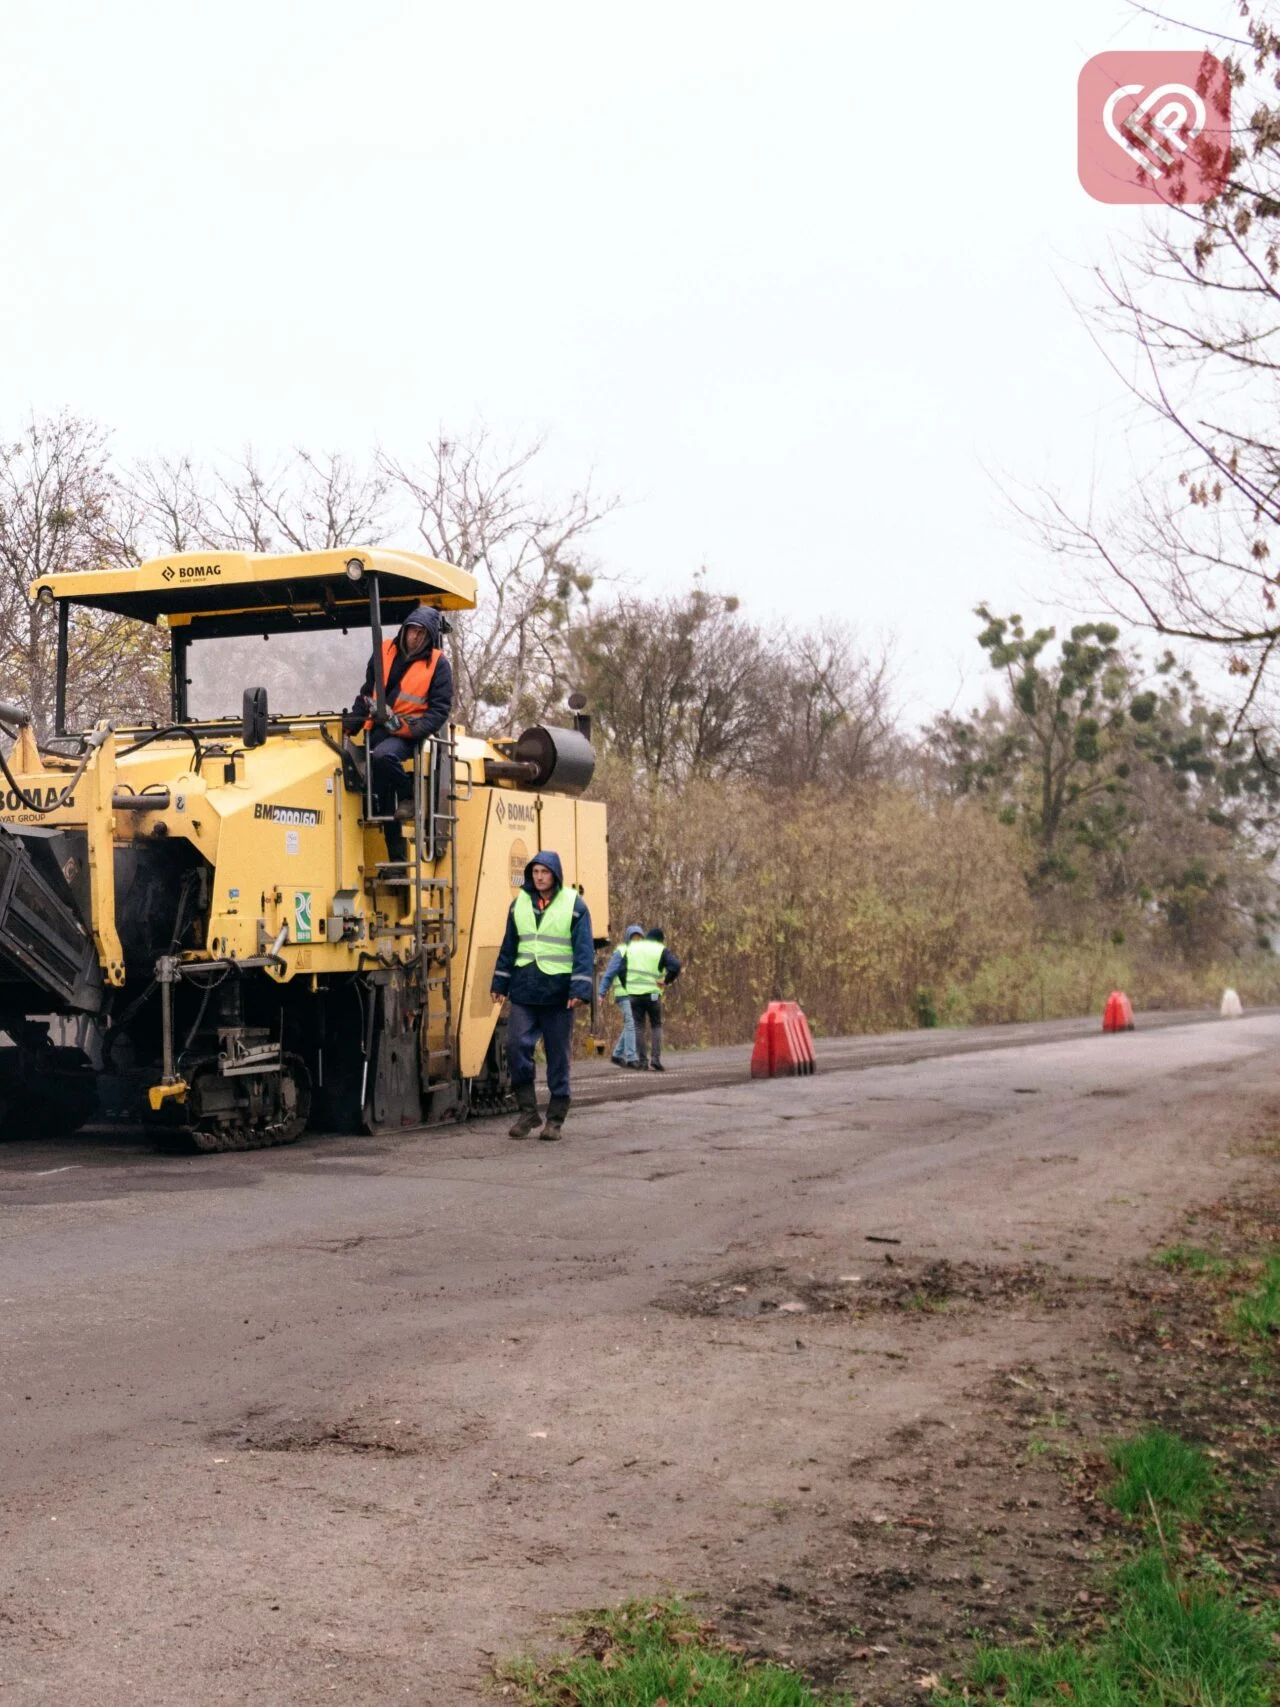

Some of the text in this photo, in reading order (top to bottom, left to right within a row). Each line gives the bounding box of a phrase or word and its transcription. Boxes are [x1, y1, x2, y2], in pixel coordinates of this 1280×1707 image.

[179, 565, 221, 578] BOMAG
[18, 813, 46, 823] GROUP
[508, 803, 535, 823] BOMAG
